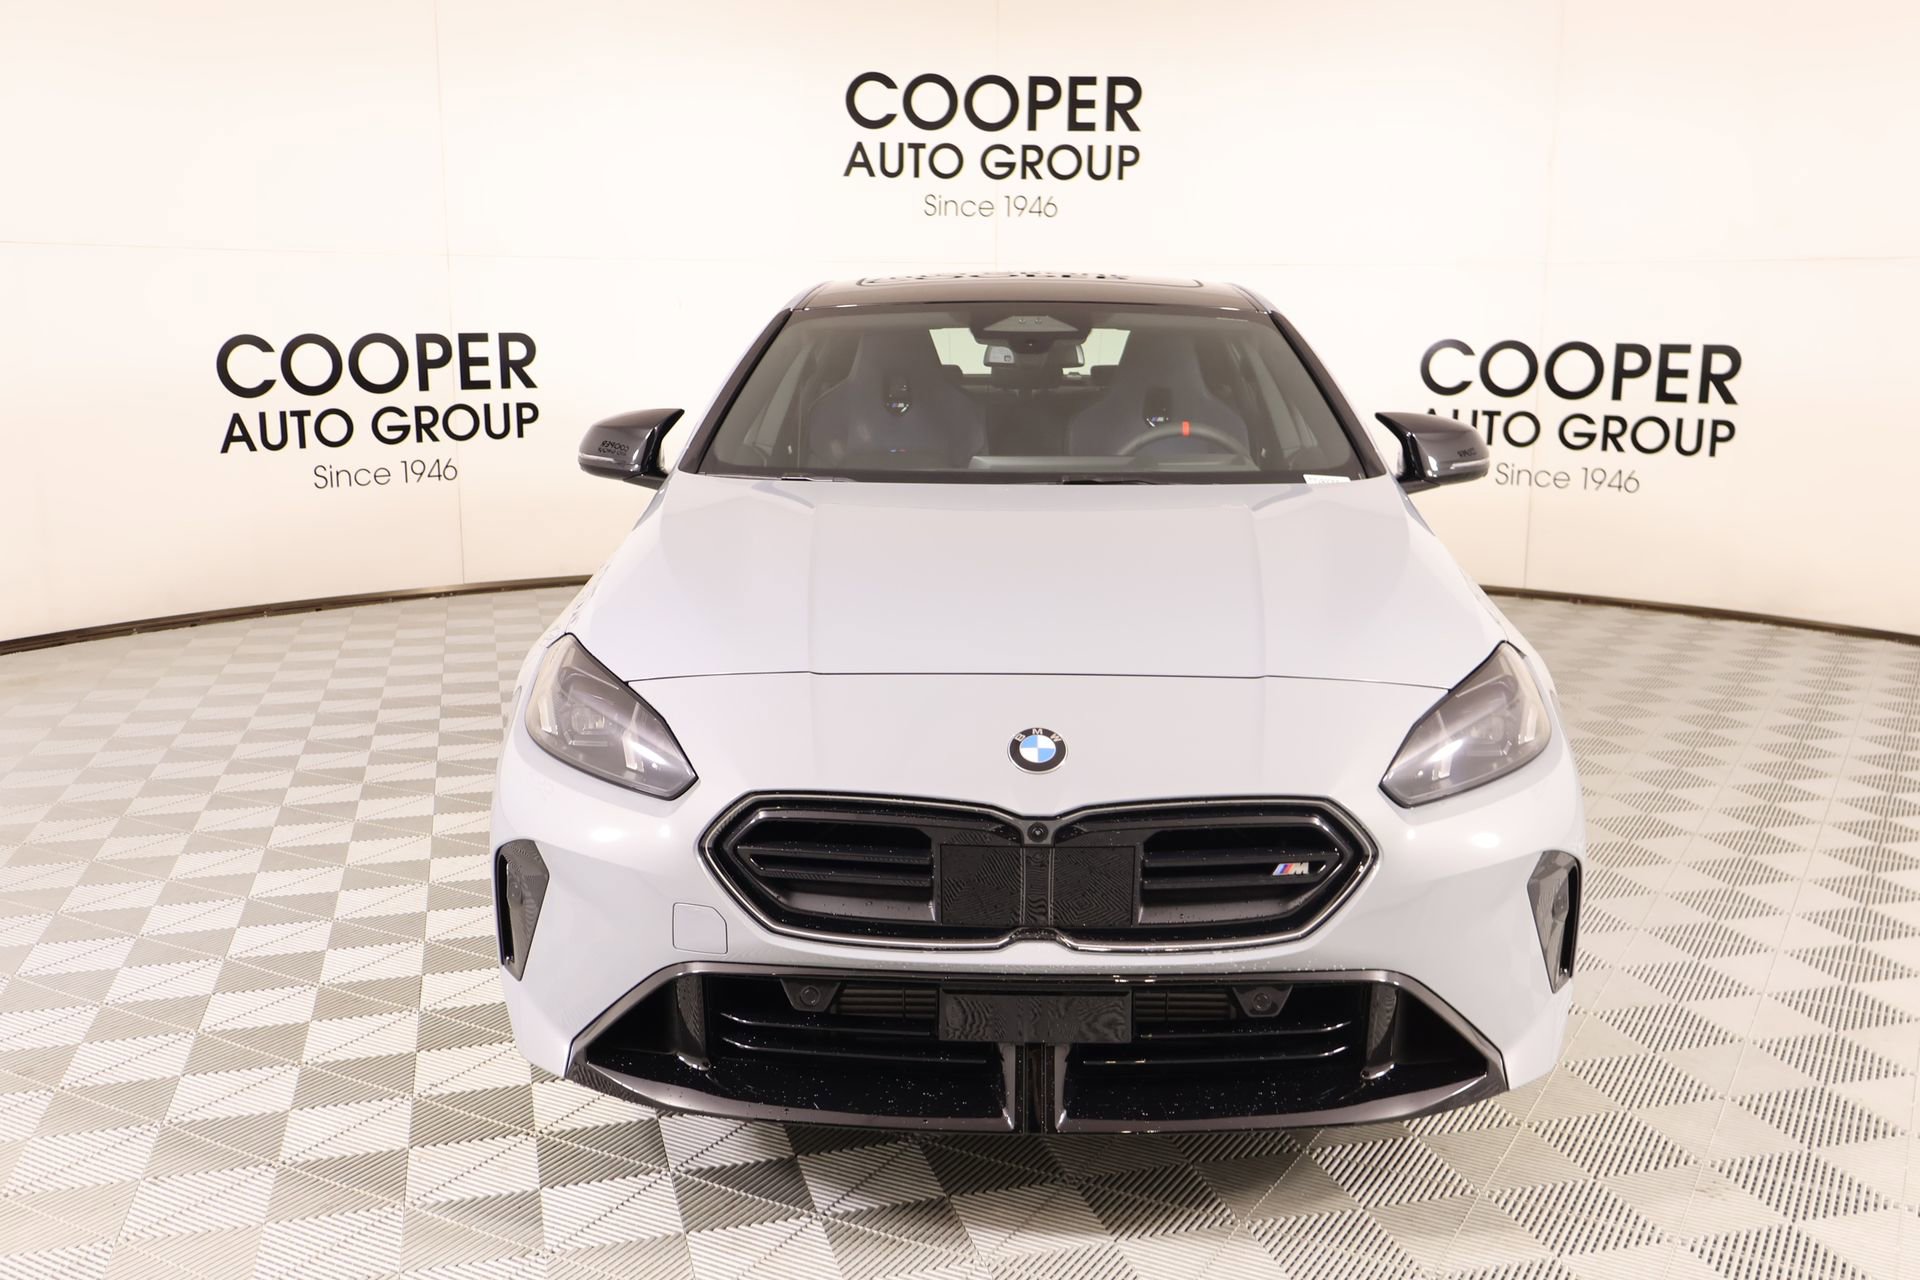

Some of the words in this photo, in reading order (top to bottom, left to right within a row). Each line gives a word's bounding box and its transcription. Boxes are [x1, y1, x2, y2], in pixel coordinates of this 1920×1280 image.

[845, 72, 1142, 132] COOPER
[843, 141, 964, 179] AUTO
[980, 143, 1141, 180] GROUP
[924, 194, 995, 217] Since
[1004, 195, 1058, 218] 1946
[216, 332, 538, 398] COOPER
[1420, 339, 1742, 405] COOPER
[220, 408, 355, 454] AUTO
[371, 402, 540, 445] GROUP
[1558, 413, 1736, 457] GROUP
[313, 464, 391, 489] Since
[400, 457, 458, 483] 1946
[1495, 462, 1571, 489] Since
[1581, 466, 1641, 493] 1946
[1015, 728, 1062, 742] BMW
